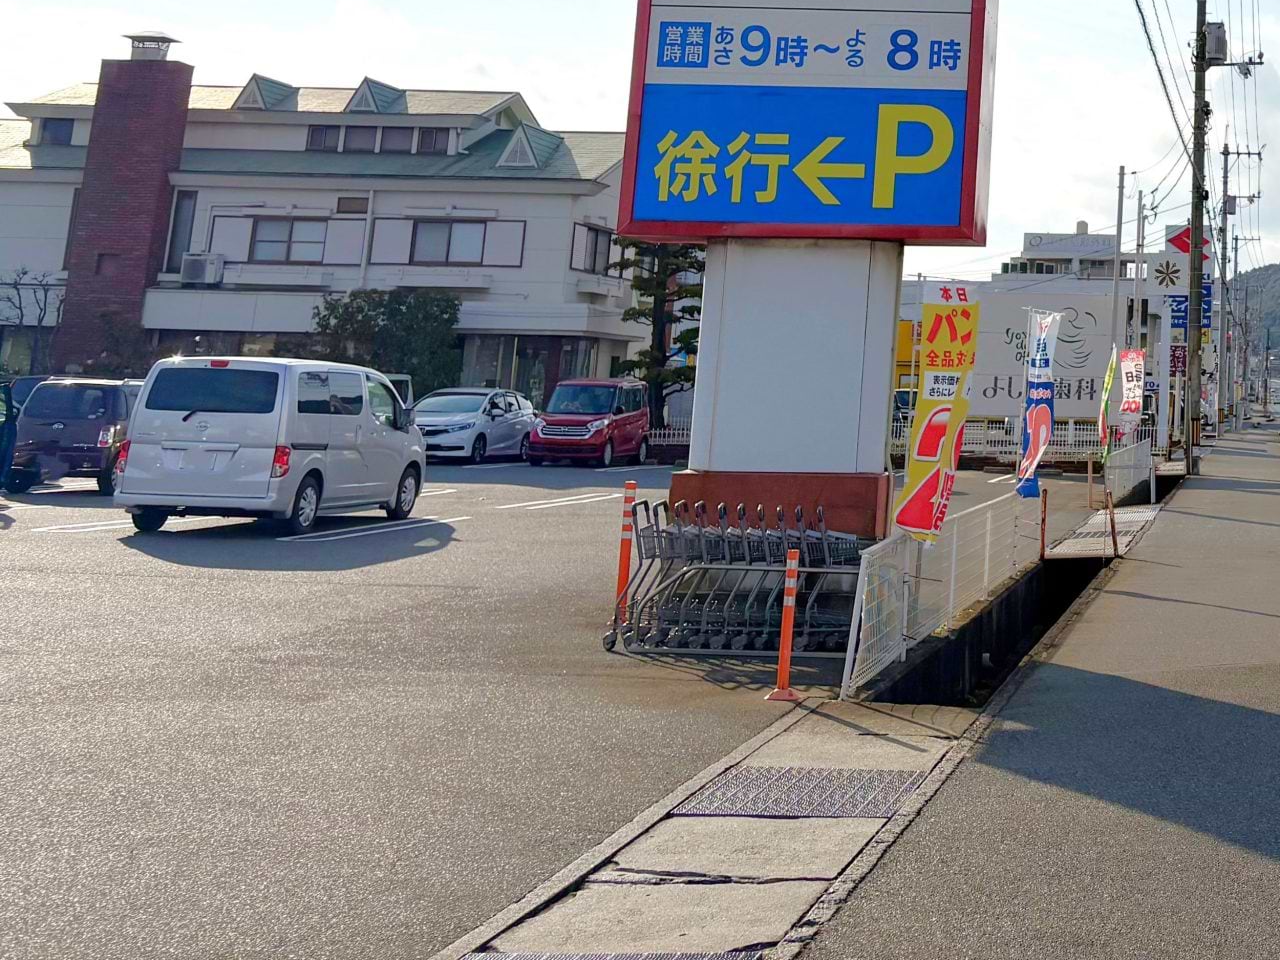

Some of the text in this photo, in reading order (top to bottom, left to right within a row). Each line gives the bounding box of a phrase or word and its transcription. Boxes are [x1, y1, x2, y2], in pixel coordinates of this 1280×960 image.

[662, 45, 703, 64] 時間
[664, 26, 704, 43] 営業
[714, 26, 735, 66] あさ
[654, 129, 790, 204] 徐行
[872, 103, 954, 209] P
